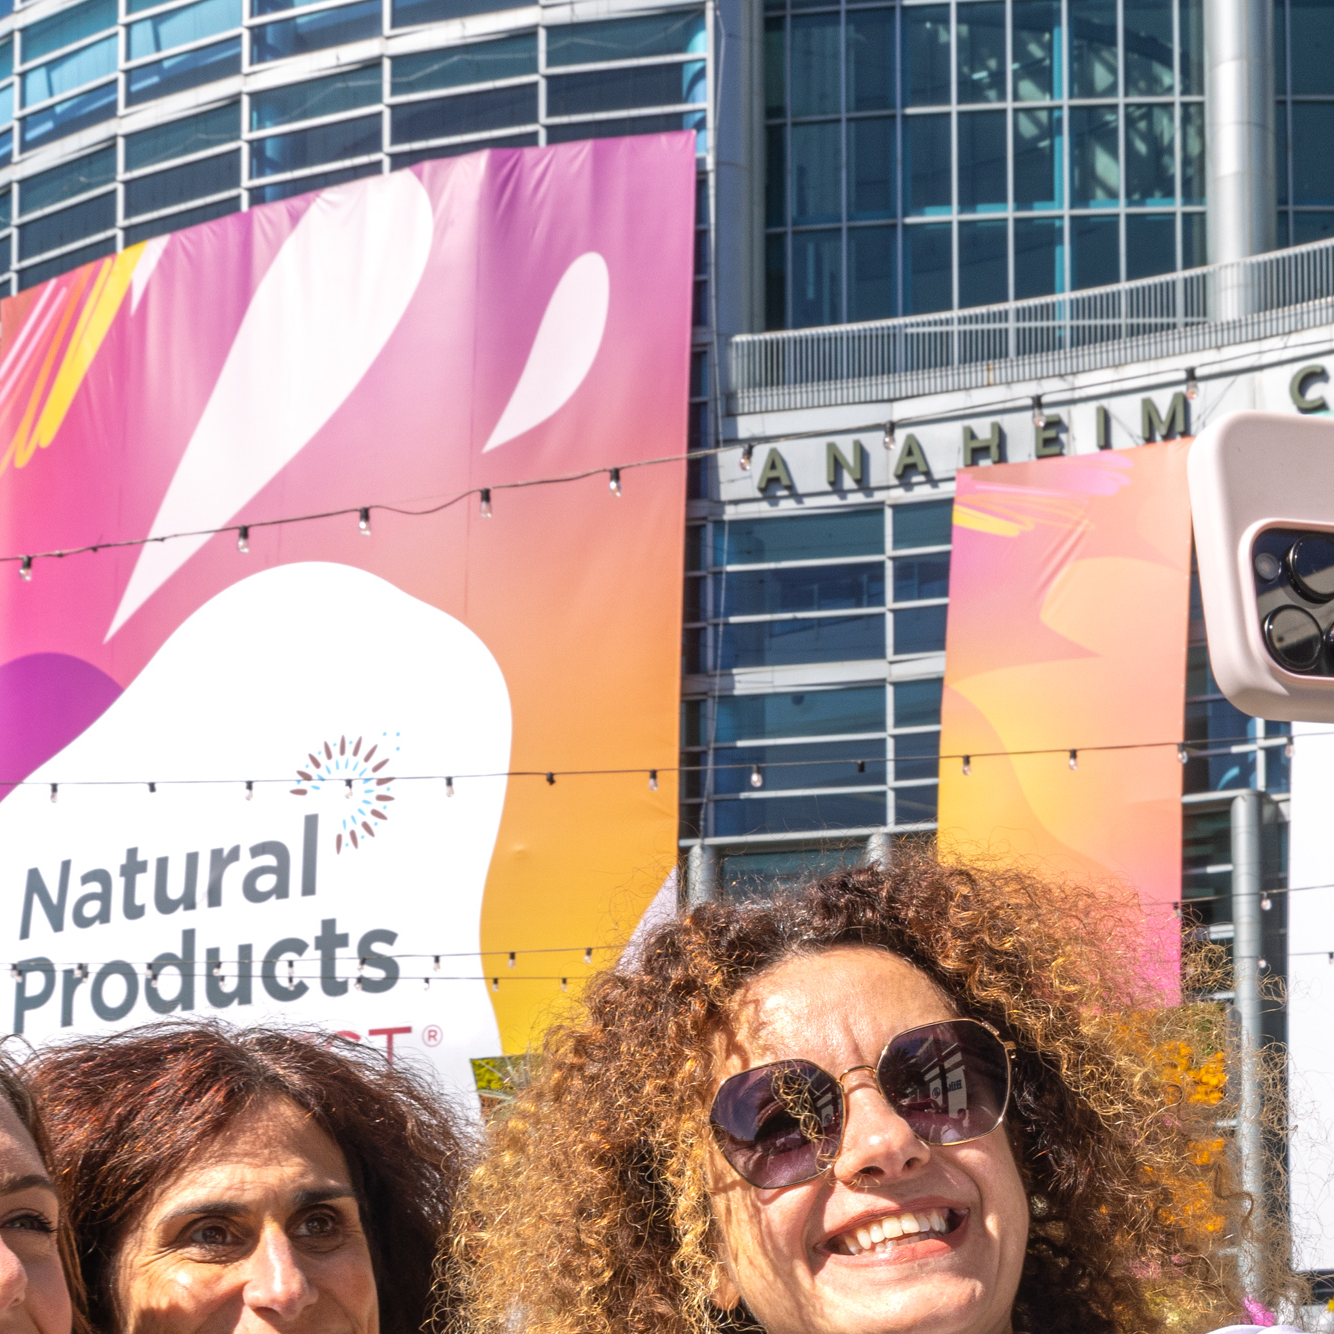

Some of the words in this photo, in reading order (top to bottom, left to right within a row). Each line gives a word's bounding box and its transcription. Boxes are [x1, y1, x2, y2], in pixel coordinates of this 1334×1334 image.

[758, 392, 1189, 492] ANAHEIM
[19, 813, 319, 940] Natural
[13, 917, 400, 1034] Products
